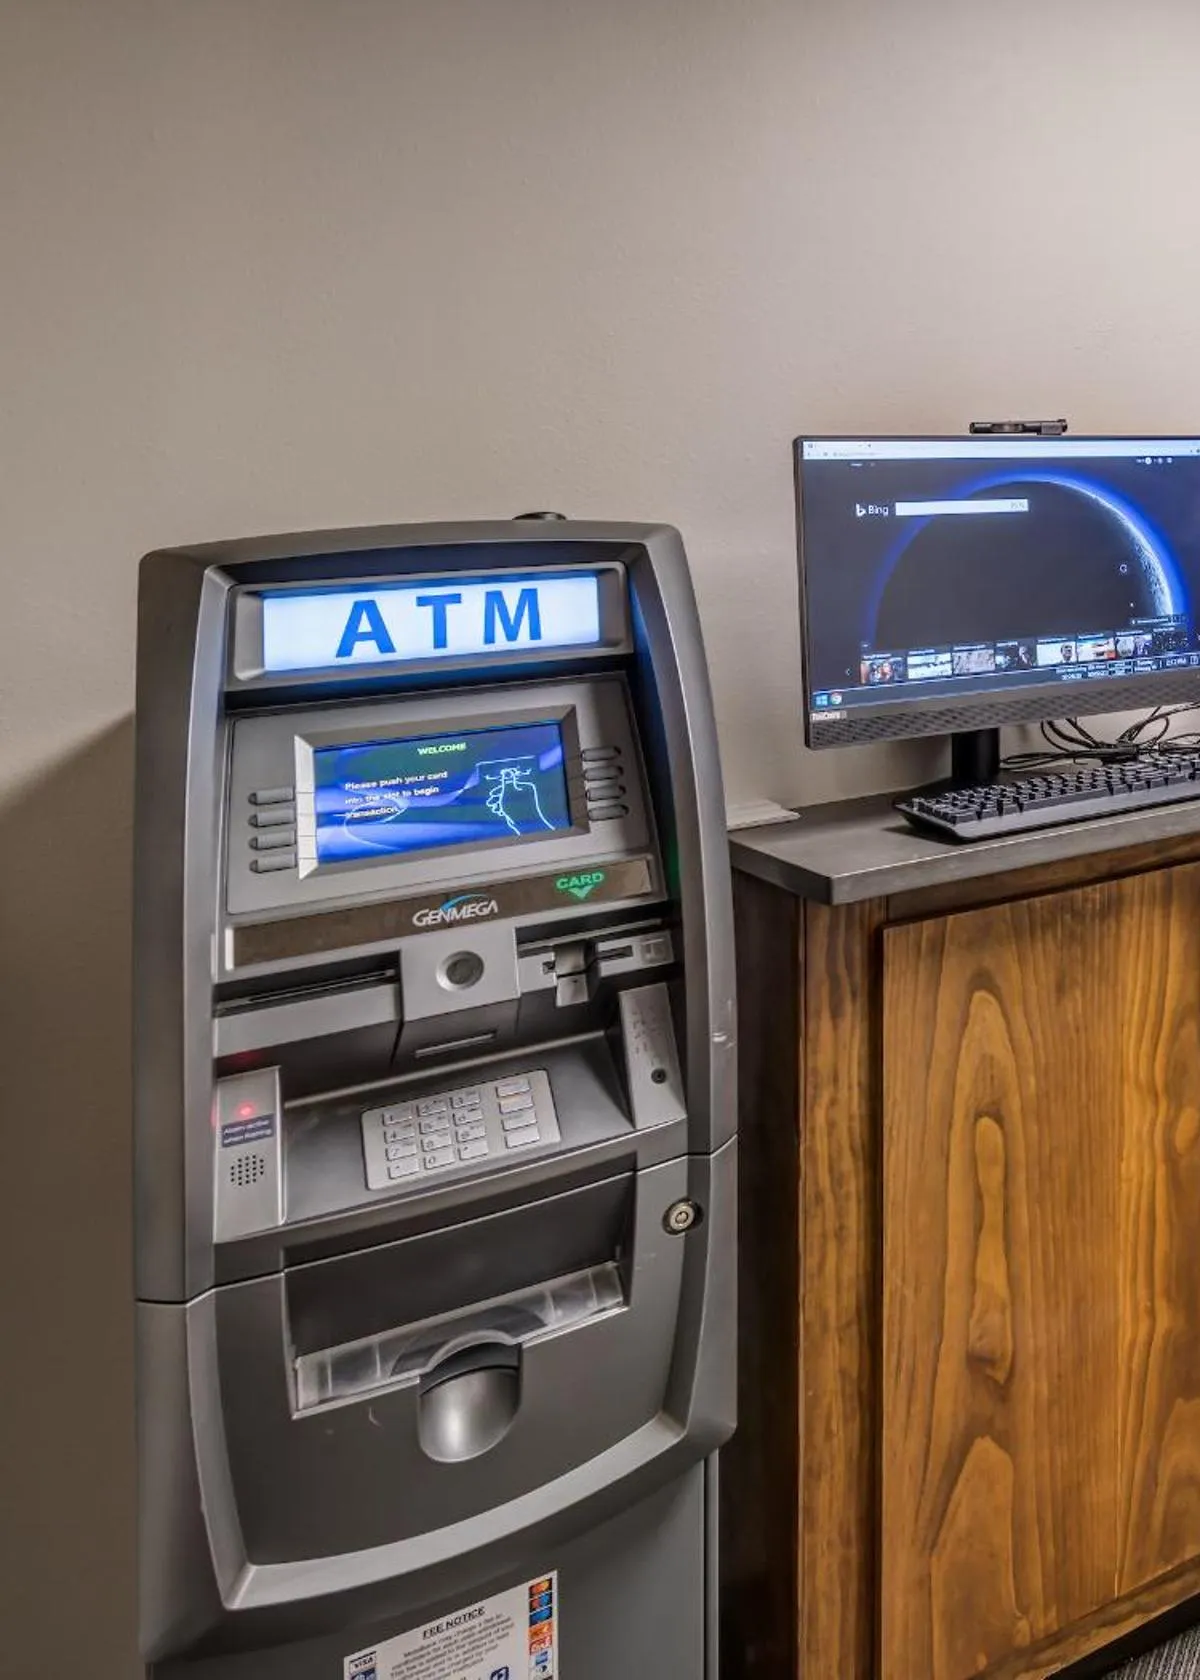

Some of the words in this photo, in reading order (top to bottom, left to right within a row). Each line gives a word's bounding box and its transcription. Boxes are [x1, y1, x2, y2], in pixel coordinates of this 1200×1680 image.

[868, 503, 889, 517] Bing
[336, 588, 541, 658] ATM
[379, 777, 403, 788] push
[404, 774, 425, 786] your
[414, 786, 439, 797] begin
[557, 872, 604, 889] CARD
[412, 900, 498, 926] GENMEGA
[422, 1623, 445, 1640] FEE
[446, 1606, 486, 1630] NOTICE
